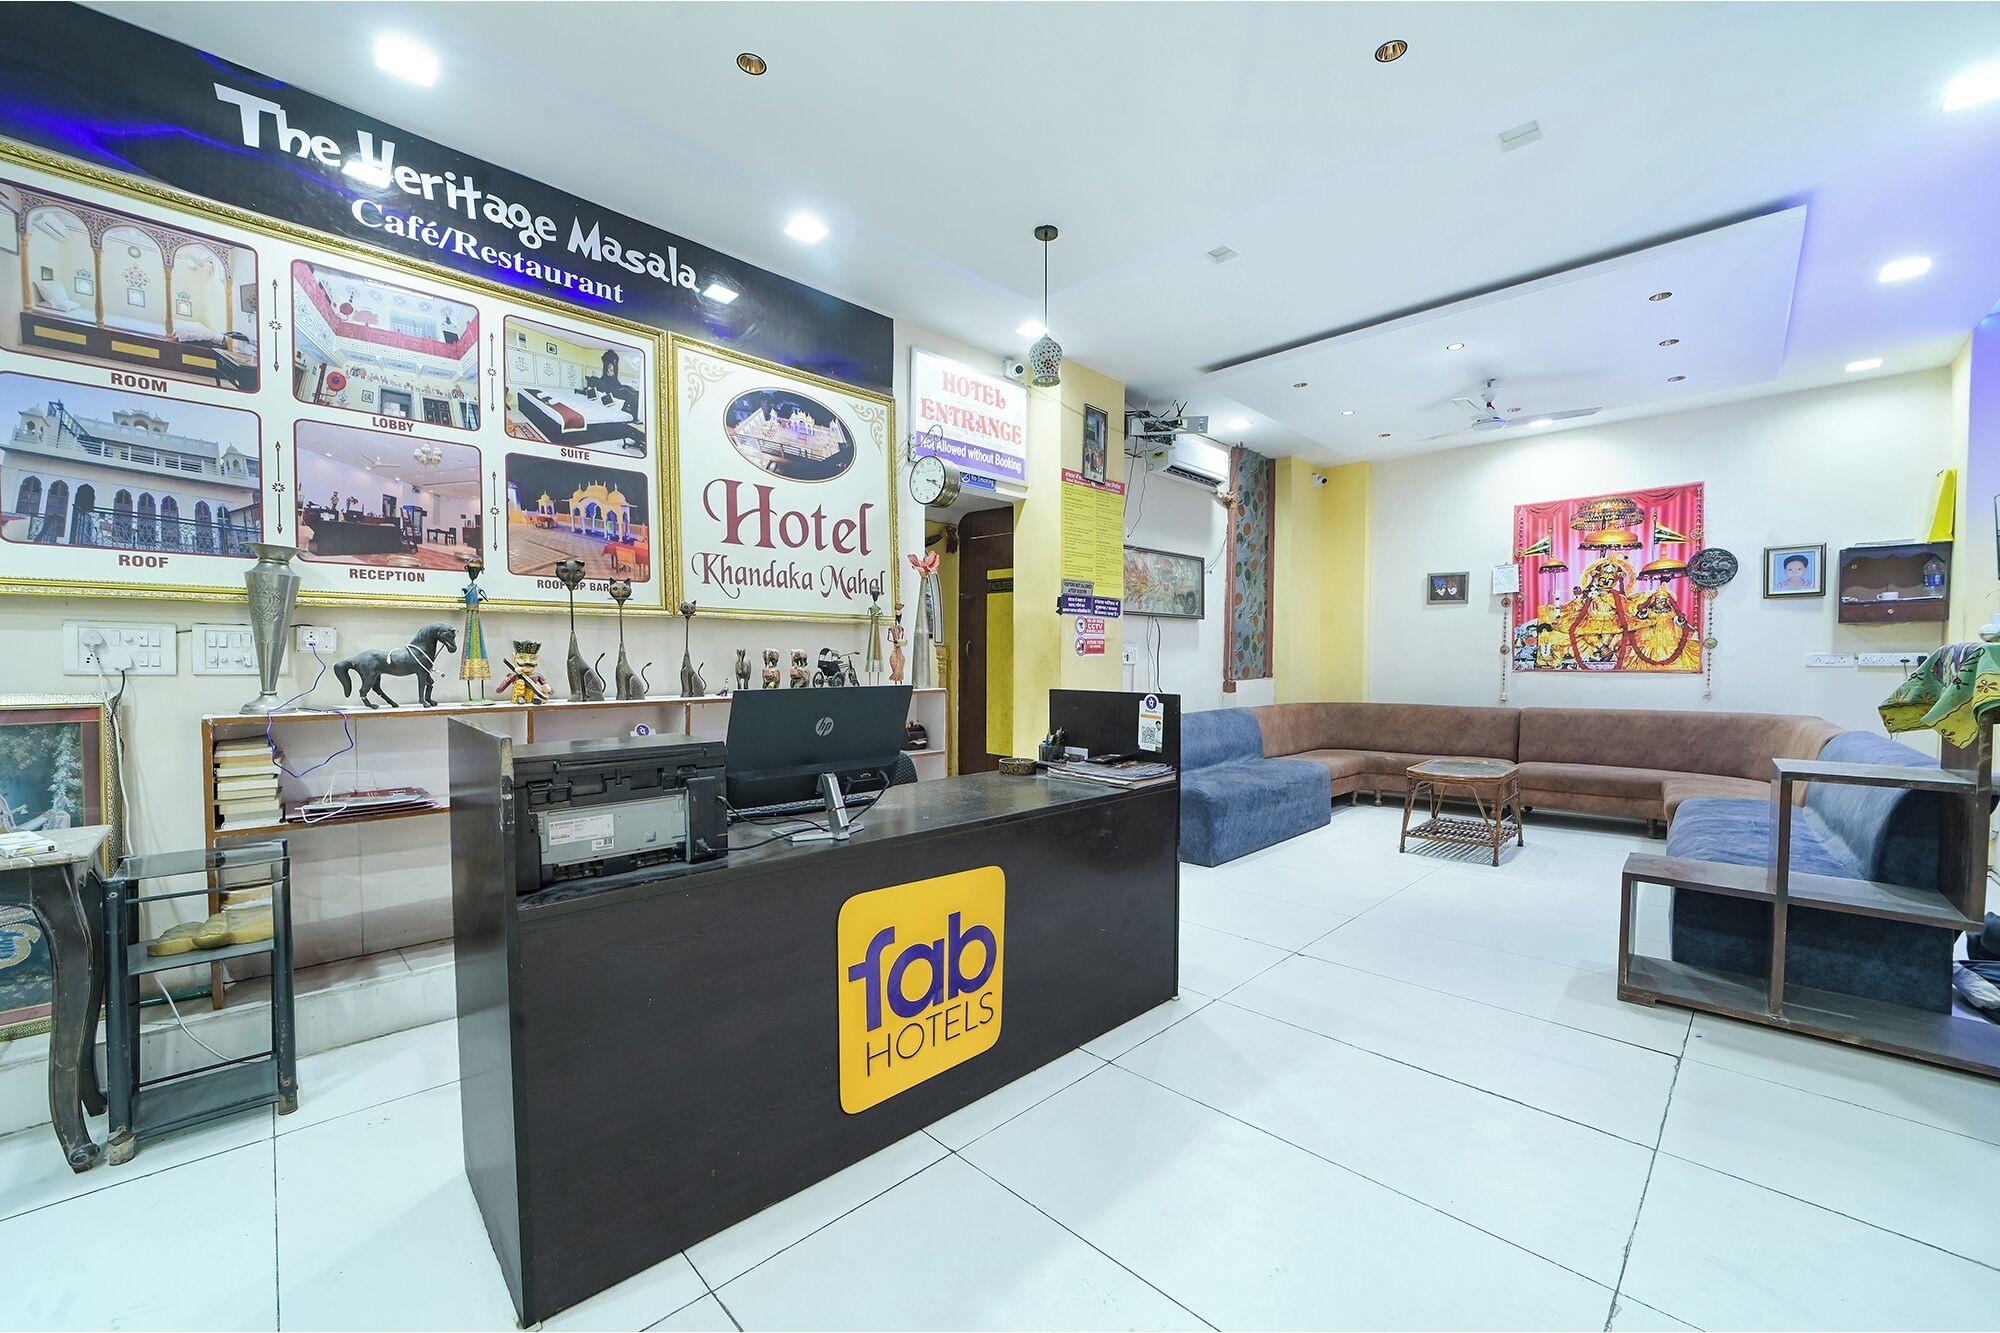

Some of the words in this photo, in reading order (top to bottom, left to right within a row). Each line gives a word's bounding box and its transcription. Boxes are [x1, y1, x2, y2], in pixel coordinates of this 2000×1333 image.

[213, 82, 342, 167] The
[566, 215, 701, 293] Masala
[351, 198, 624, 304] Café/Restaurant
[110, 372, 167, 393] ROOM
[942, 370, 1006, 410] HOTEL
[372, 416, 414, 433] LOBBY
[920, 397, 1022, 445] ENTRANCE
[560, 447, 590, 461] SUITE
[920, 434, 935, 449] Not
[936, 438, 967, 458] Allowed
[968, 447, 995, 464] without
[995, 453, 1022, 474] Booking
[702, 478, 874, 556] Hotel
[118, 554, 169, 568] ROOF
[349, 568, 425, 583] RECEPTION
[691, 552, 813, 599] Khandaka
[820, 564, 886, 600] Mahal
[590, 582, 610, 591] BAR
[848, 911, 997, 1033] fab
[866, 991, 994, 1077] HOTELS
